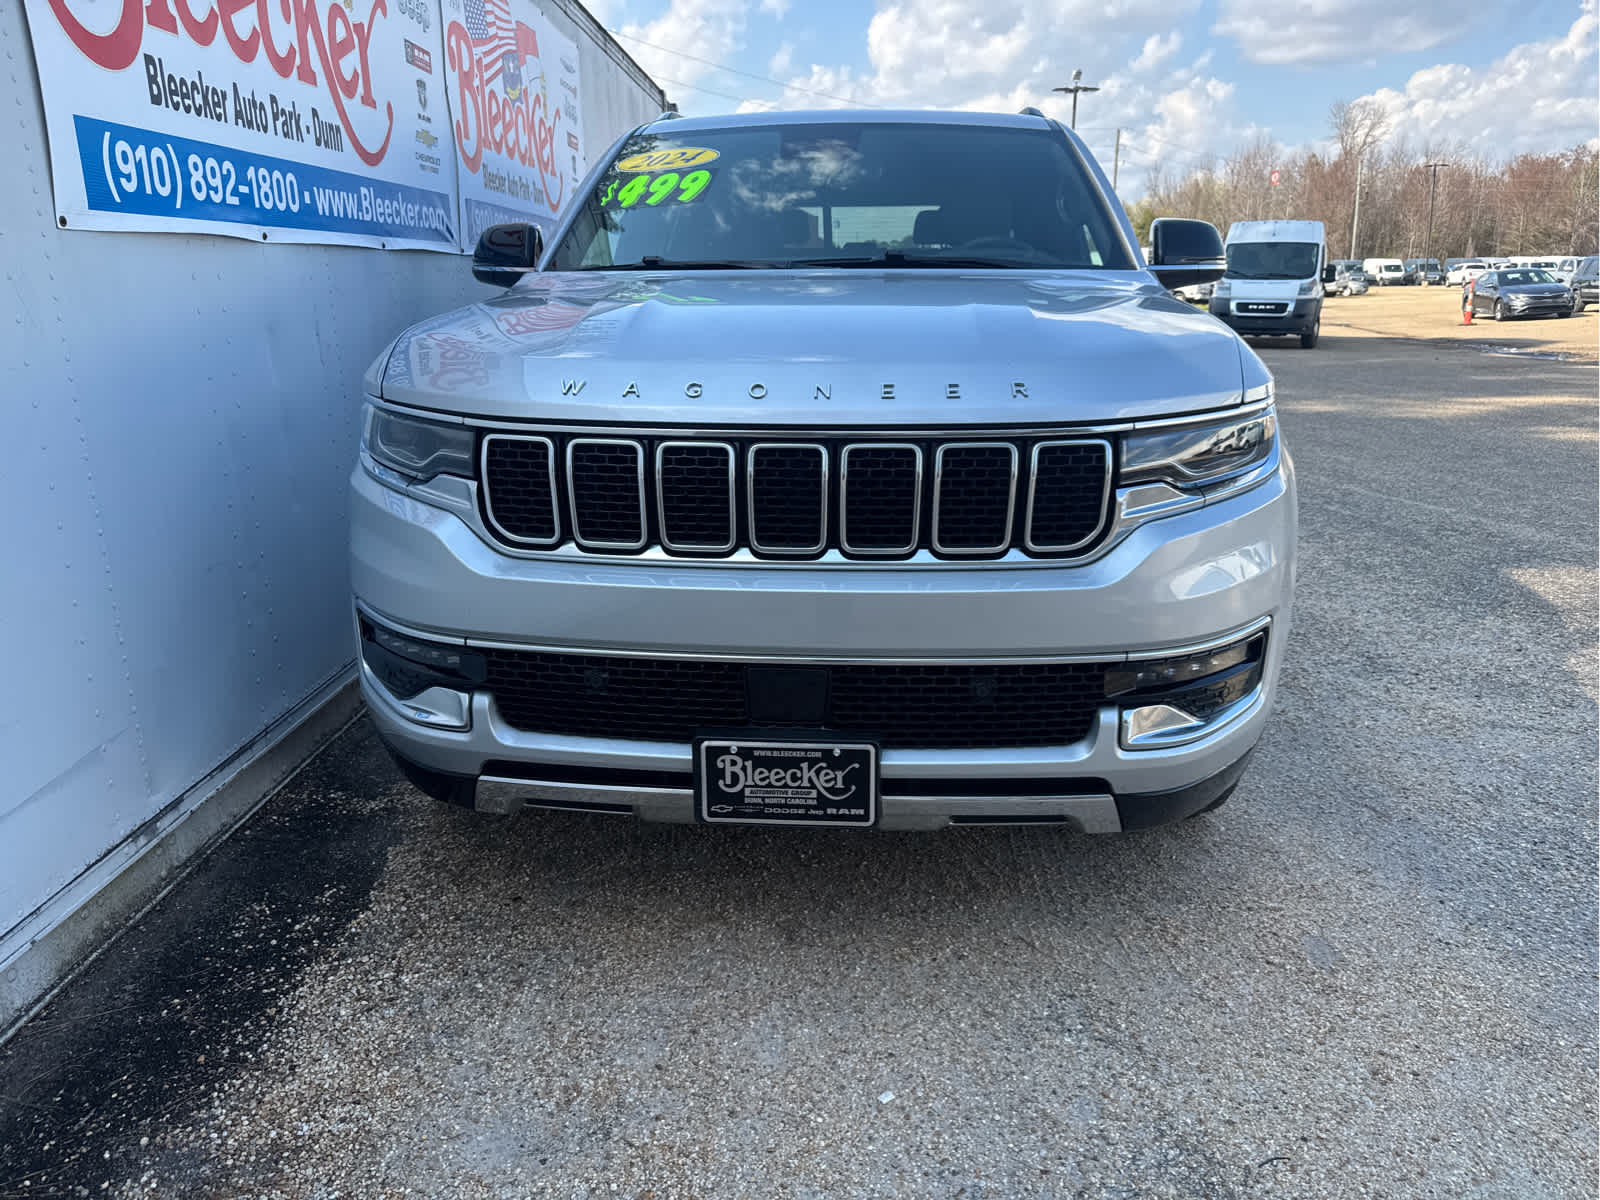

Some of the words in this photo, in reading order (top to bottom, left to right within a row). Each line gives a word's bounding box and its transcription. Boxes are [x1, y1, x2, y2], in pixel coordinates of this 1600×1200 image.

[49, 0, 393, 167] ecker
[143, 53, 228, 124] Bleecker
[233, 82, 268, 135] Auto
[269, 94, 304, 143] Park
[312, 107, 344, 153] Dunn
[446, 20, 563, 213] Bleecker
[628, 150, 707, 170] 2024
[102, 130, 182, 209] (910)
[189, 154, 300, 214] 892-1800
[313, 186, 448, 233] www.Bleecker.com
[600, 169, 712, 208] $499
[560, 379, 1030, 400] WAGONEER
[753, 750, 822, 758] WWW.BLEECKER.COM
[716, 754, 860, 800] Bleecker
[826, 807, 865, 816] RAM
